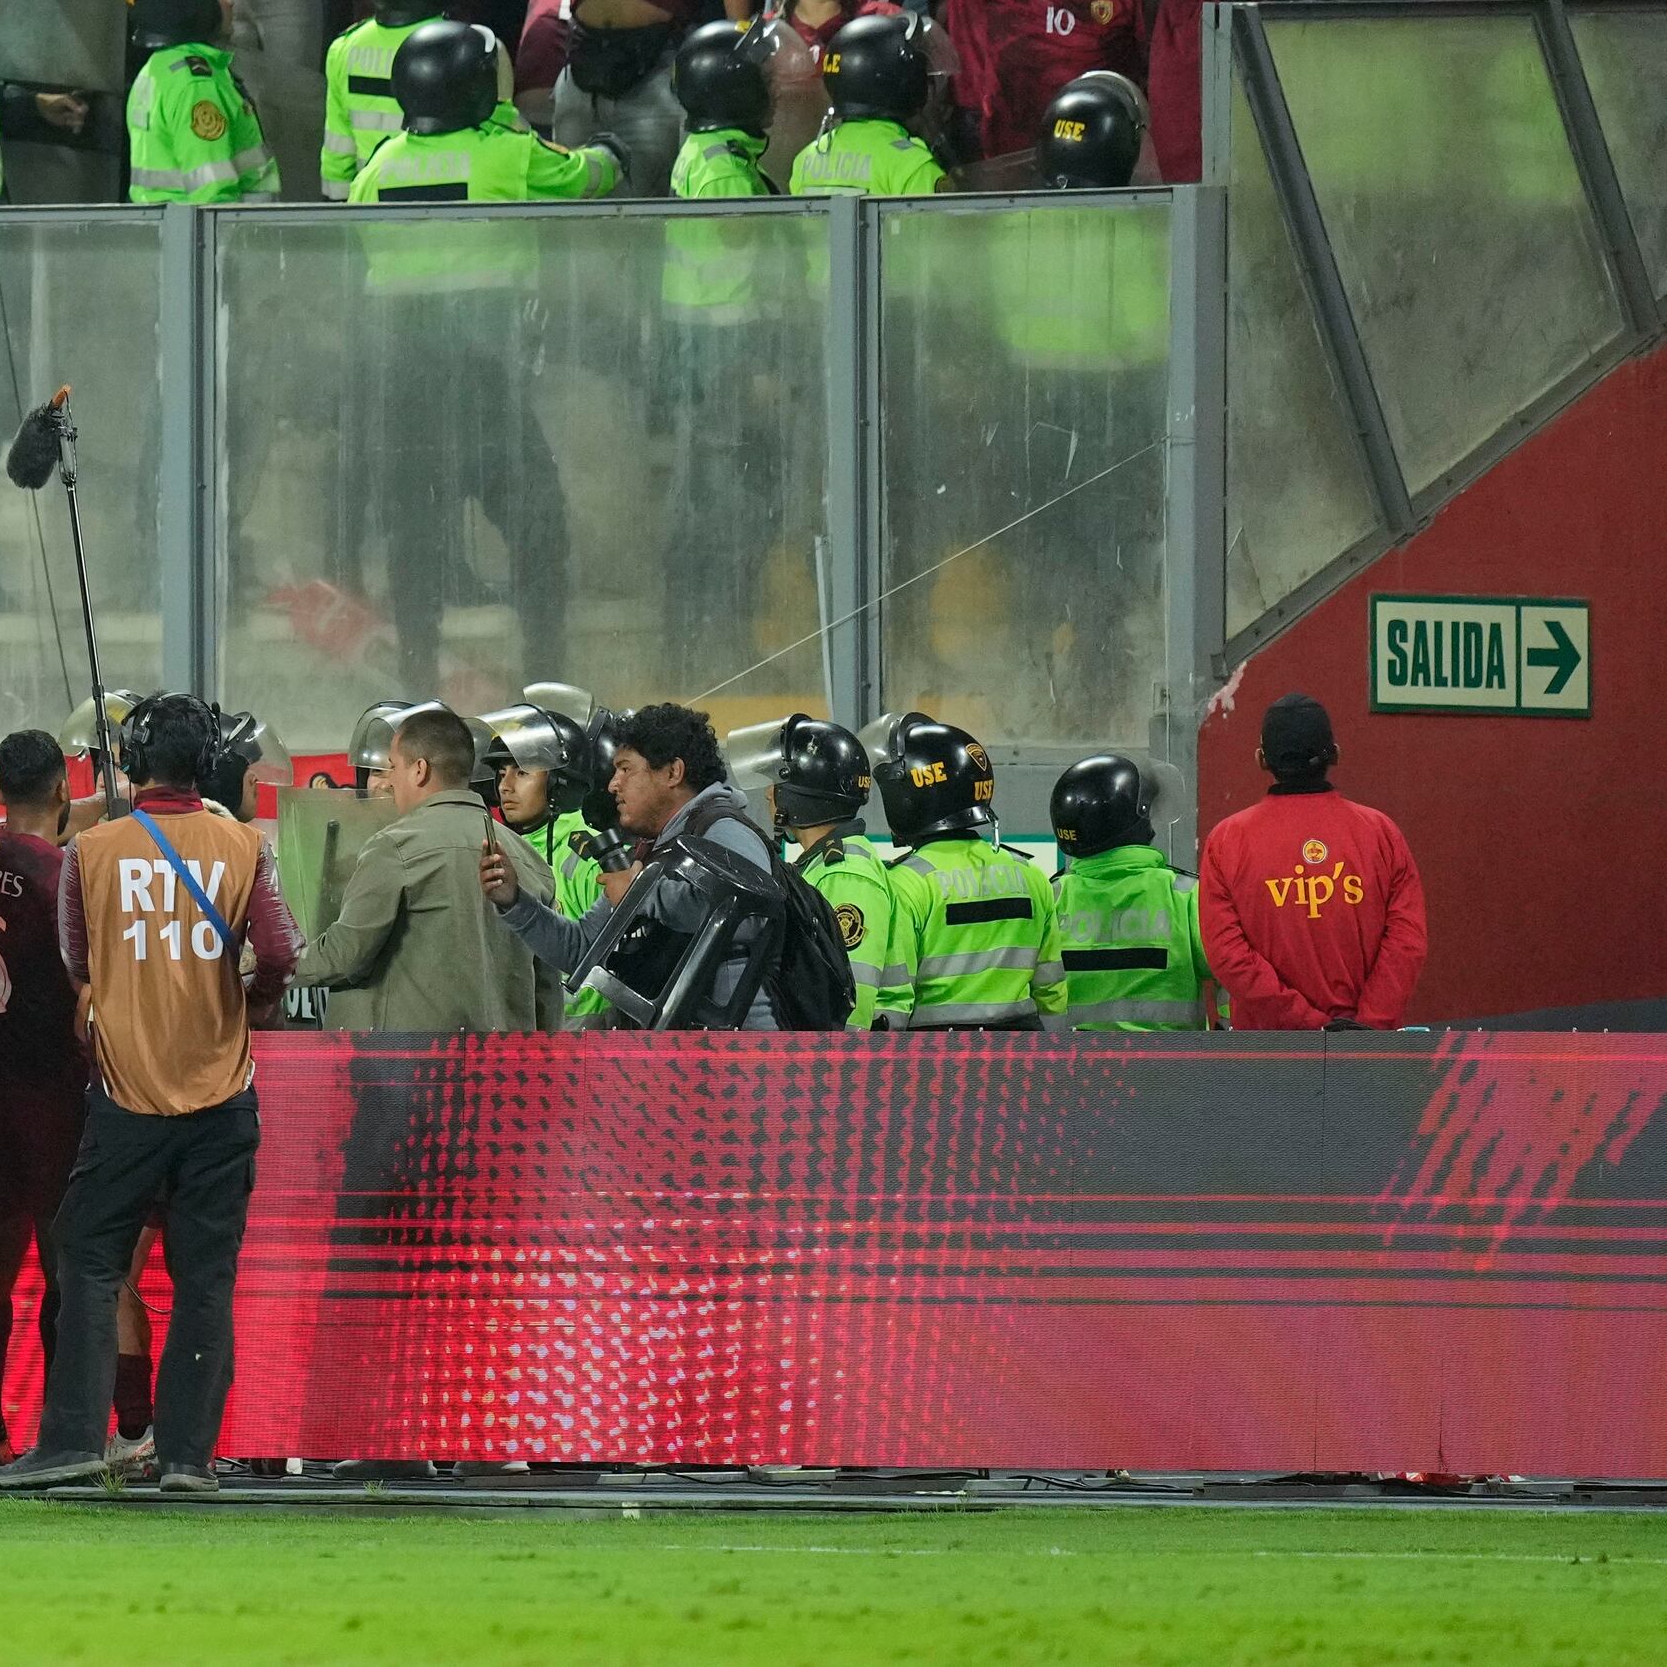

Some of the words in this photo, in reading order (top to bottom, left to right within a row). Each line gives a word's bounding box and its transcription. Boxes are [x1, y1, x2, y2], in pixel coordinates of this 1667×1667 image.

[1045, 8, 1076, 37] 10
[347, 49, 392, 74] POLI
[1053, 119, 1085, 143] USE
[1387, 617, 1508, 691] SALIDA
[910, 761, 949, 789] USE
[974, 779, 994, 802] USE
[1056, 827, 1078, 841] USE
[117, 856, 226, 914] RTV
[936, 863, 1028, 901] POLICIA
[123, 920, 225, 962] 110
